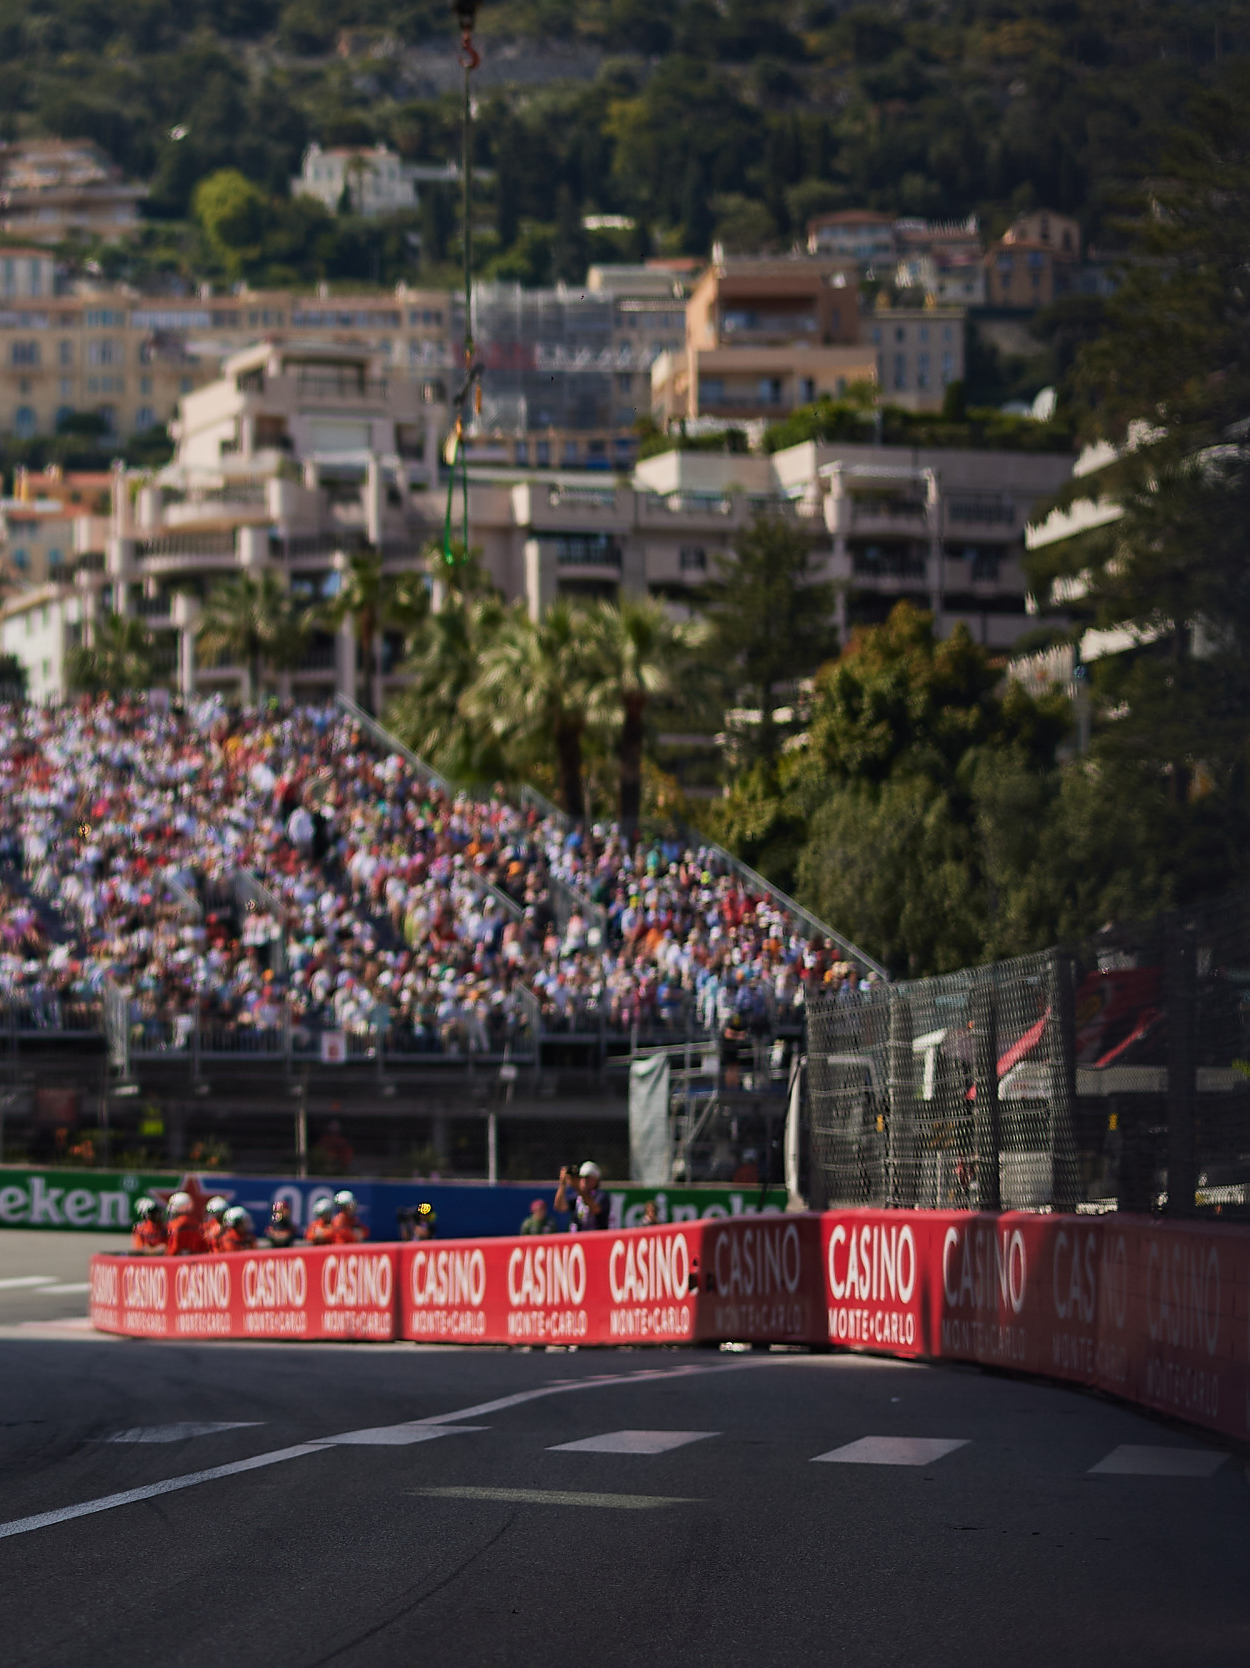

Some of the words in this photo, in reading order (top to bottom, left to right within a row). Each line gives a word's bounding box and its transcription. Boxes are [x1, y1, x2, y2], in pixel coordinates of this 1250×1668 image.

[175, 1261, 231, 1310] CASINO
[241, 1256, 307, 1308] CASINO
[321, 1254, 393, 1308] CASINO
[411, 1249, 486, 1307] CASINO
[508, 1242, 587, 1306] CASINO
[609, 1232, 690, 1304] CASINO
[714, 1222, 800, 1297] CASINO
[828, 1224, 916, 1304] CASINO
[942, 1226, 1027, 1314] CASINO
